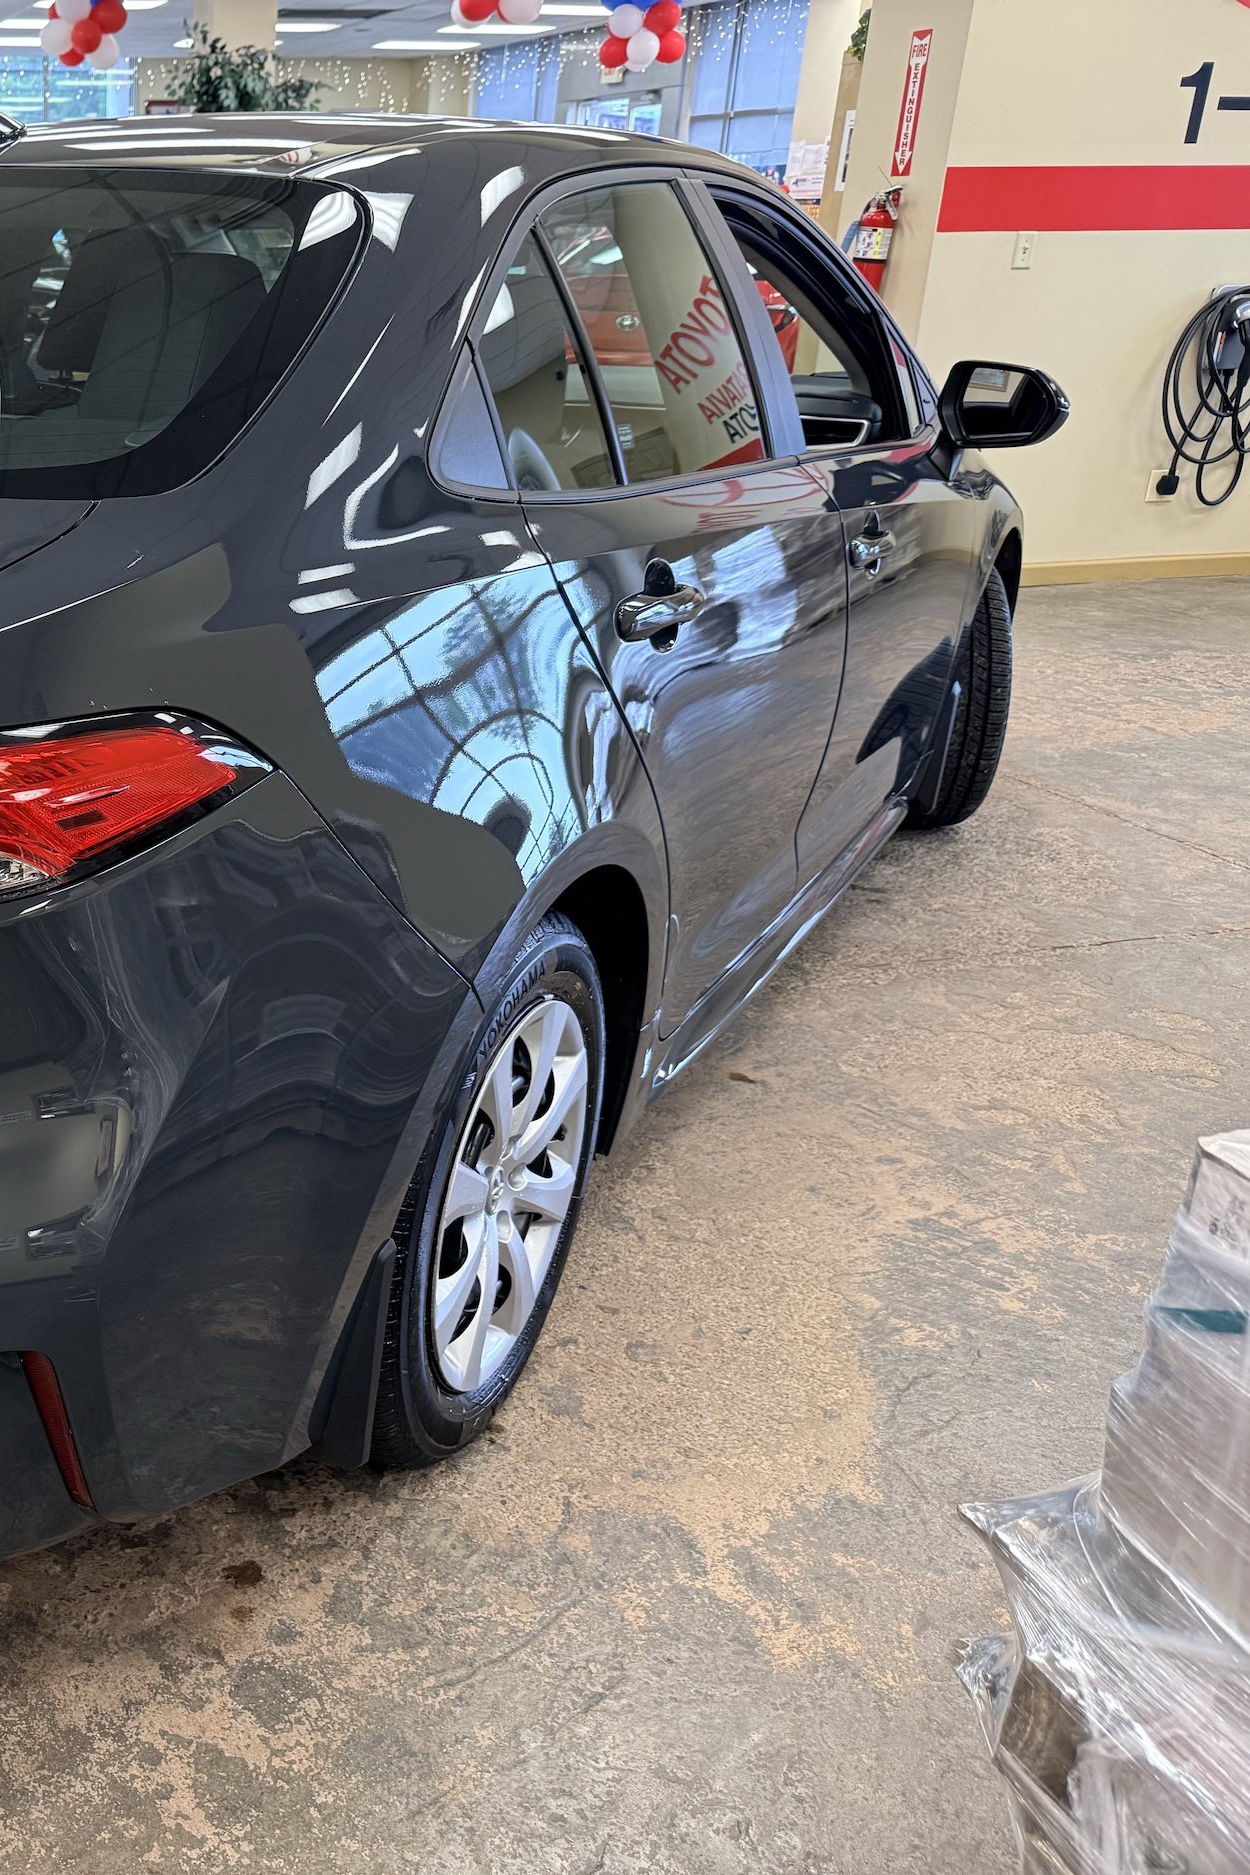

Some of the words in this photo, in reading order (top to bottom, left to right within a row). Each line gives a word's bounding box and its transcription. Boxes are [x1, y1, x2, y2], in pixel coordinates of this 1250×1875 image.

[912, 43, 928, 58] FIRE
[899, 63, 920, 166] EXTINGUISHER
[477, 960, 546, 1058] YOKOHAMA
